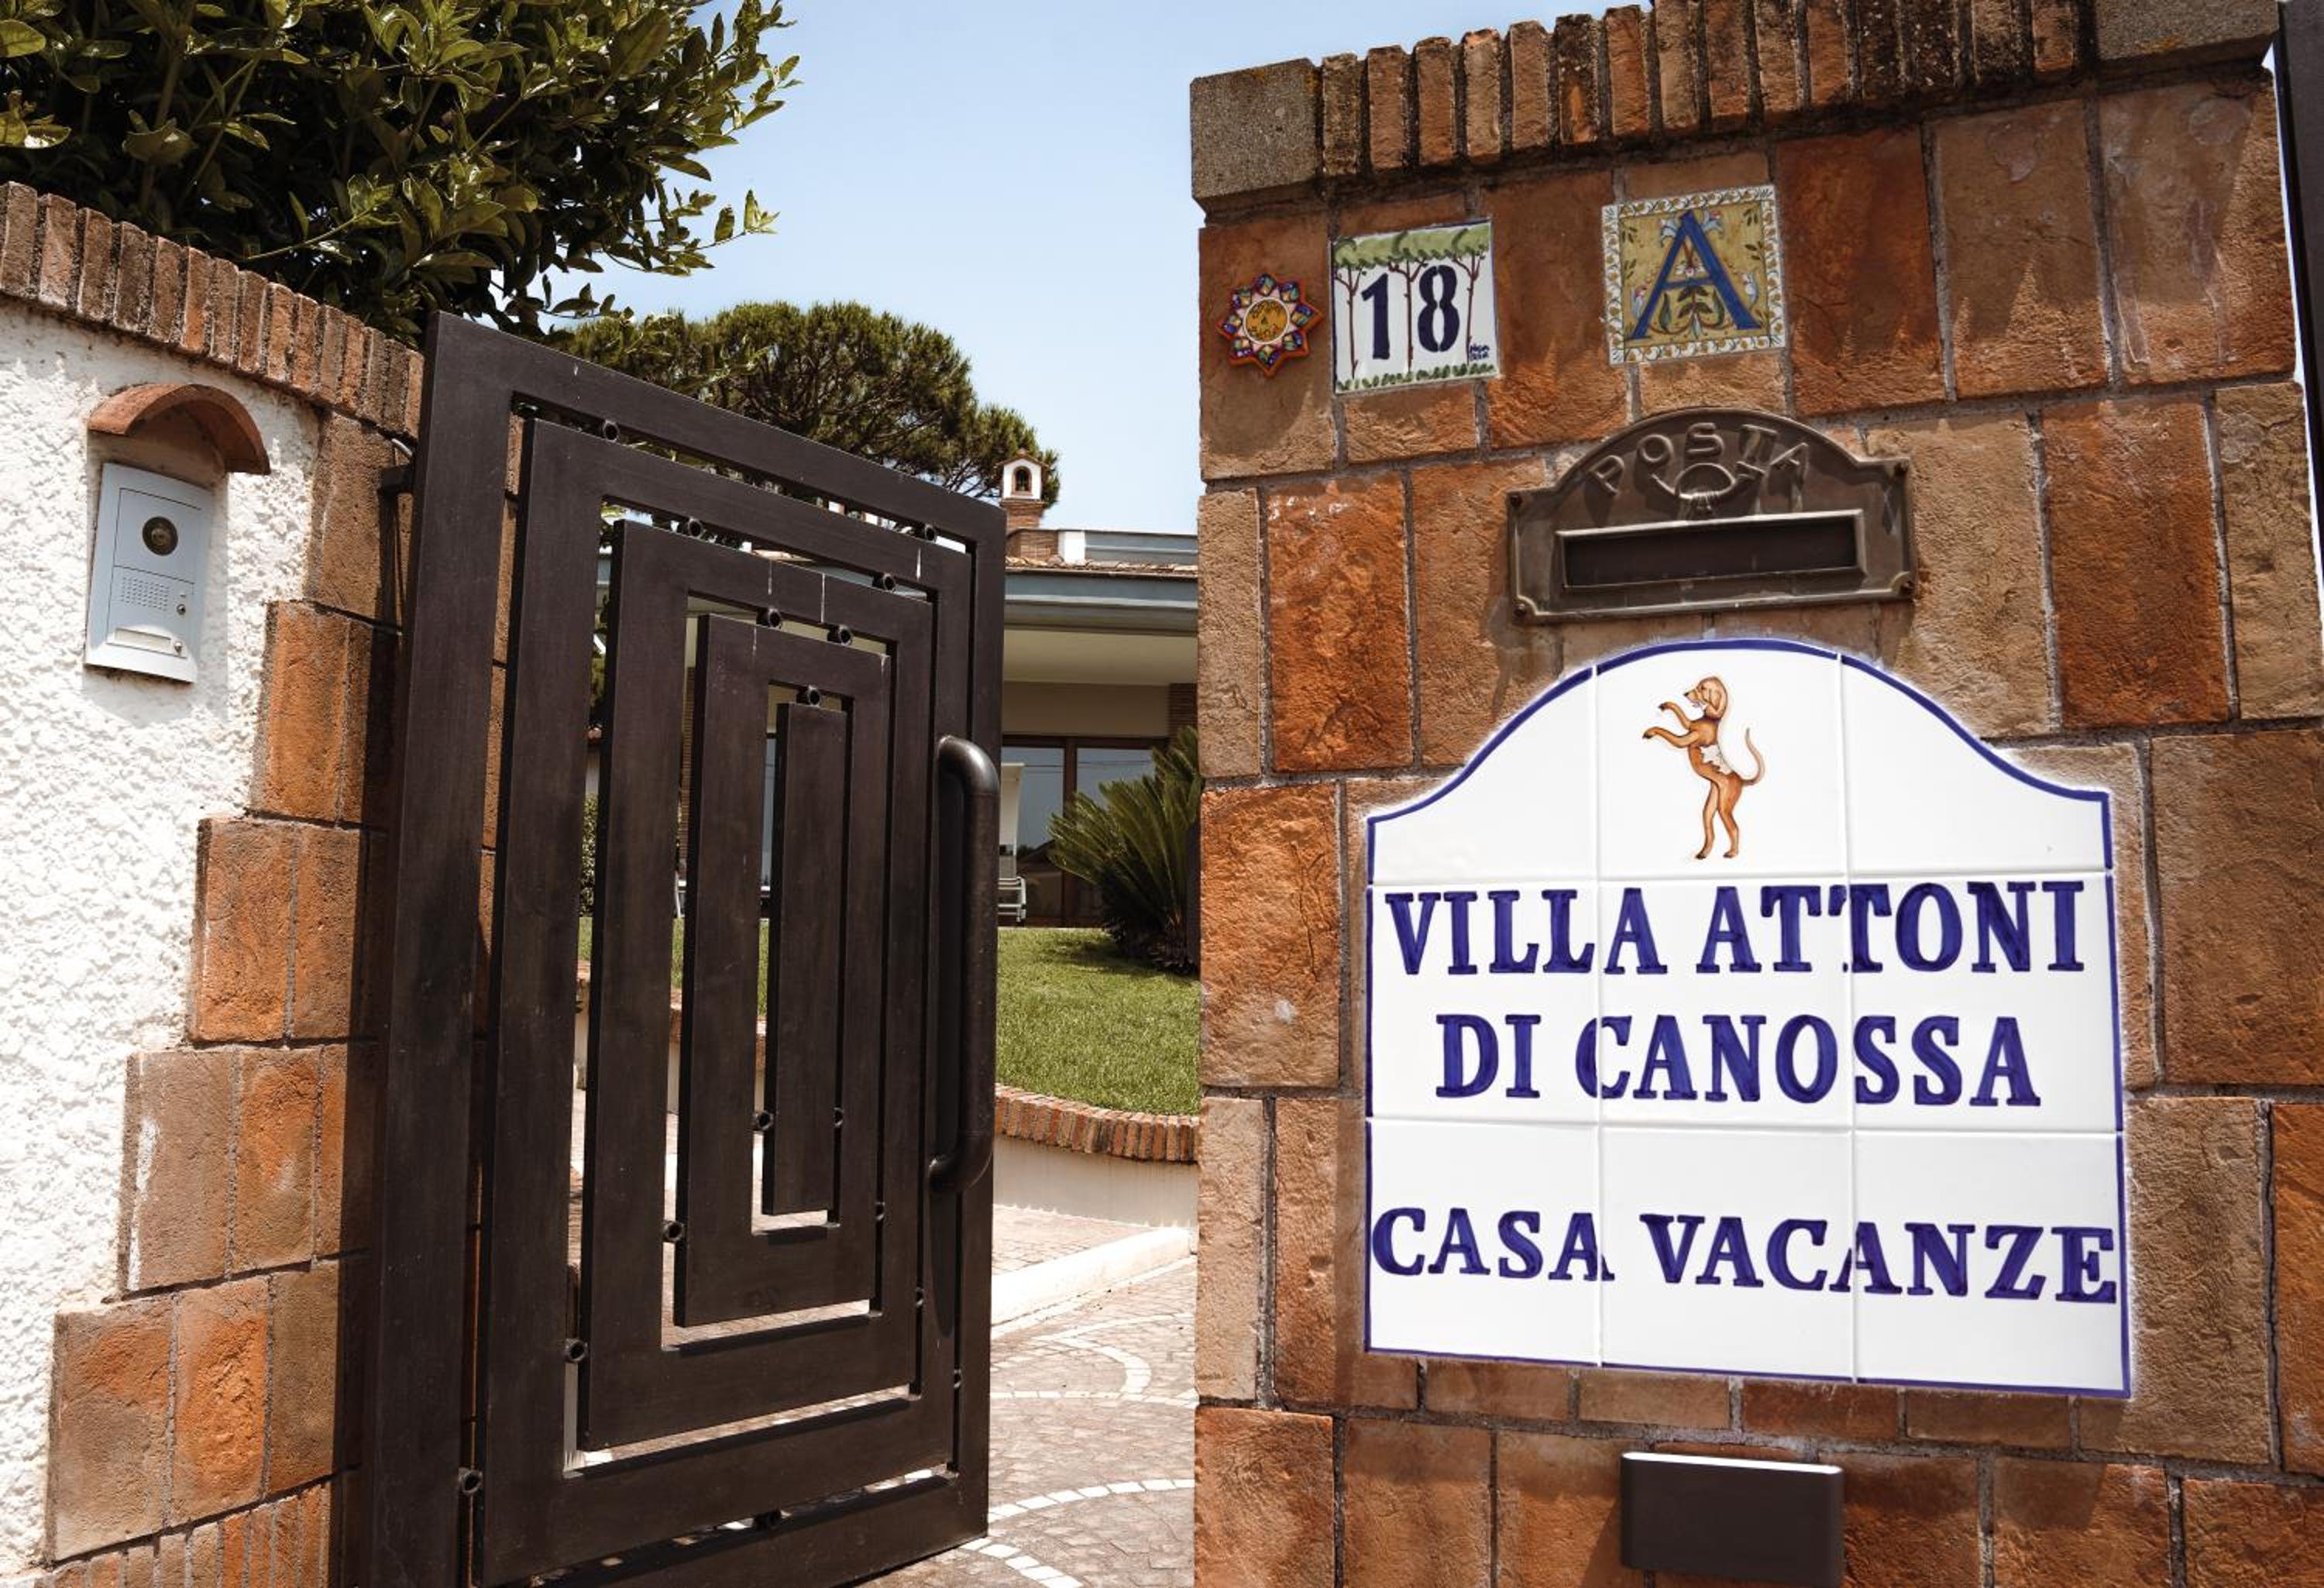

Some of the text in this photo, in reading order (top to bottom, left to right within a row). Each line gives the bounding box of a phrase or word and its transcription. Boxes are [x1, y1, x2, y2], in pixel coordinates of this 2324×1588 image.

[1361, 265, 1460, 360] 18
[1632, 211, 1762, 339] A
[1588, 422, 1809, 496] POSTA
[1384, 880, 2085, 975] VILLA ATTONI
[1435, 1014, 2041, 1107] DI CANOSSA
[1372, 1207, 2117, 1304] CASA VACANZE
